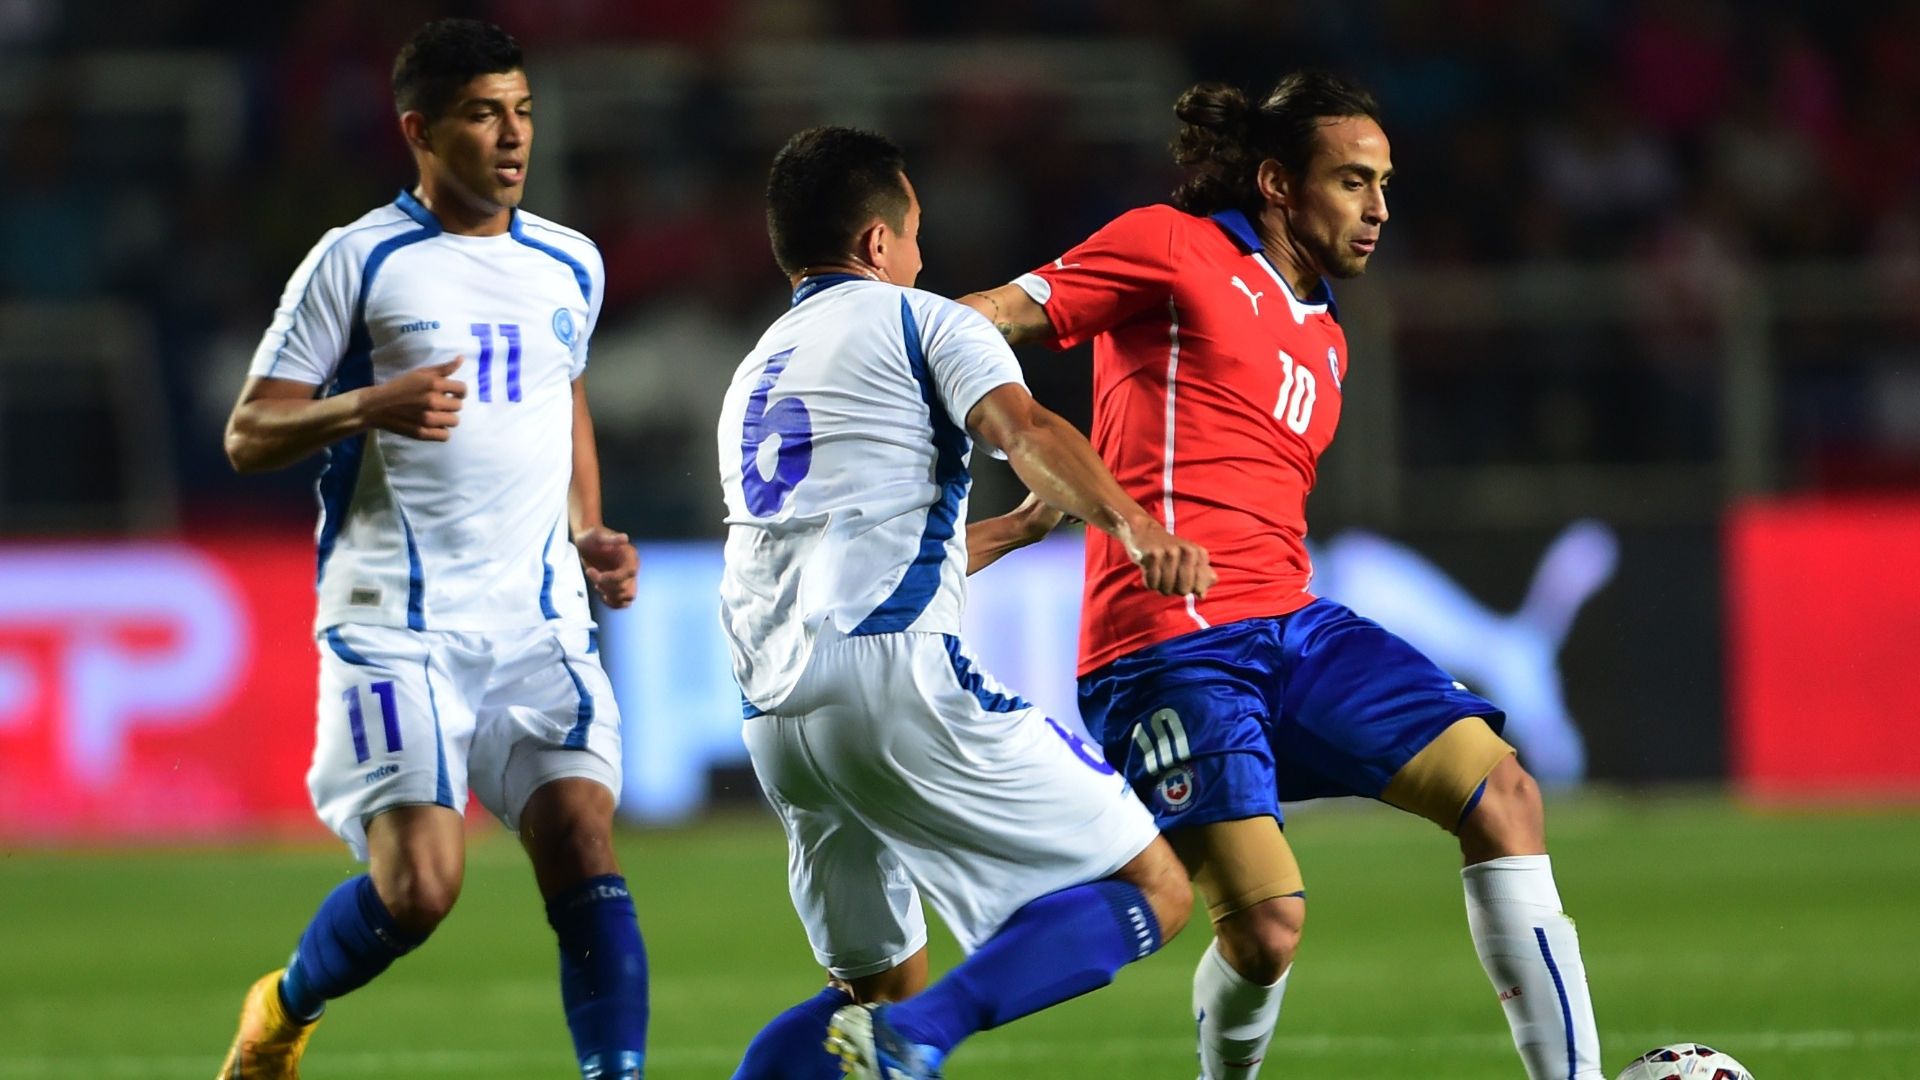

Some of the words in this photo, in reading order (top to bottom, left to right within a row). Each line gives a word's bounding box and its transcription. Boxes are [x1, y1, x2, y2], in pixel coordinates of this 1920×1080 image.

[401, 320, 440, 333] mitre
[470, 323, 522, 403] 11
[741, 345, 813, 518] 6
[1273, 350, 1316, 435] 10
[342, 680, 403, 764] 11
[1132, 708, 1191, 776] 10
[365, 764, 400, 784] mitre
